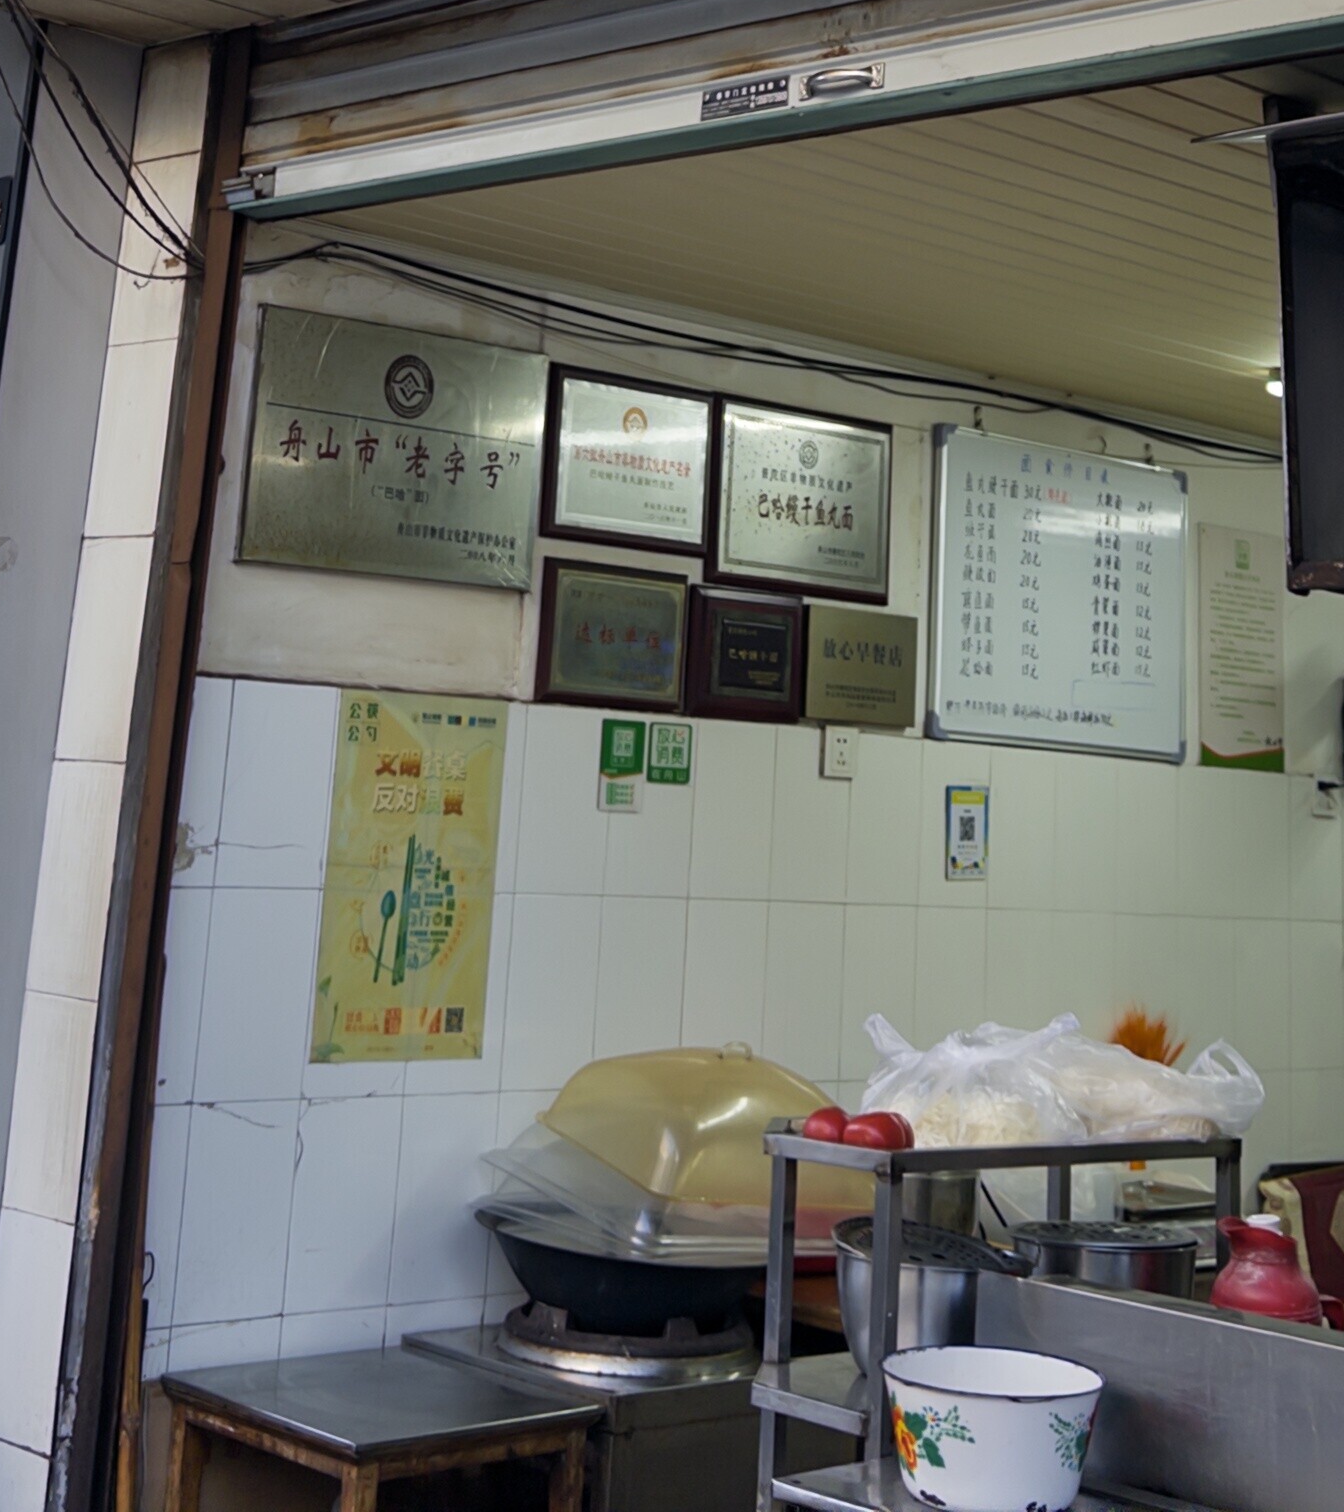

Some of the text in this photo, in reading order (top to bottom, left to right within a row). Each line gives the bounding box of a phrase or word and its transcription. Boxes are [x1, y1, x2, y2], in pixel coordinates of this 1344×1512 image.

[823, 638, 903, 668] 放心早餐店
[349, 702, 379, 721] 公筷
[347, 724, 378, 743] 公勺
[374, 750, 468, 781] 文明餐桌
[372, 784, 465, 816] 反对浪费
